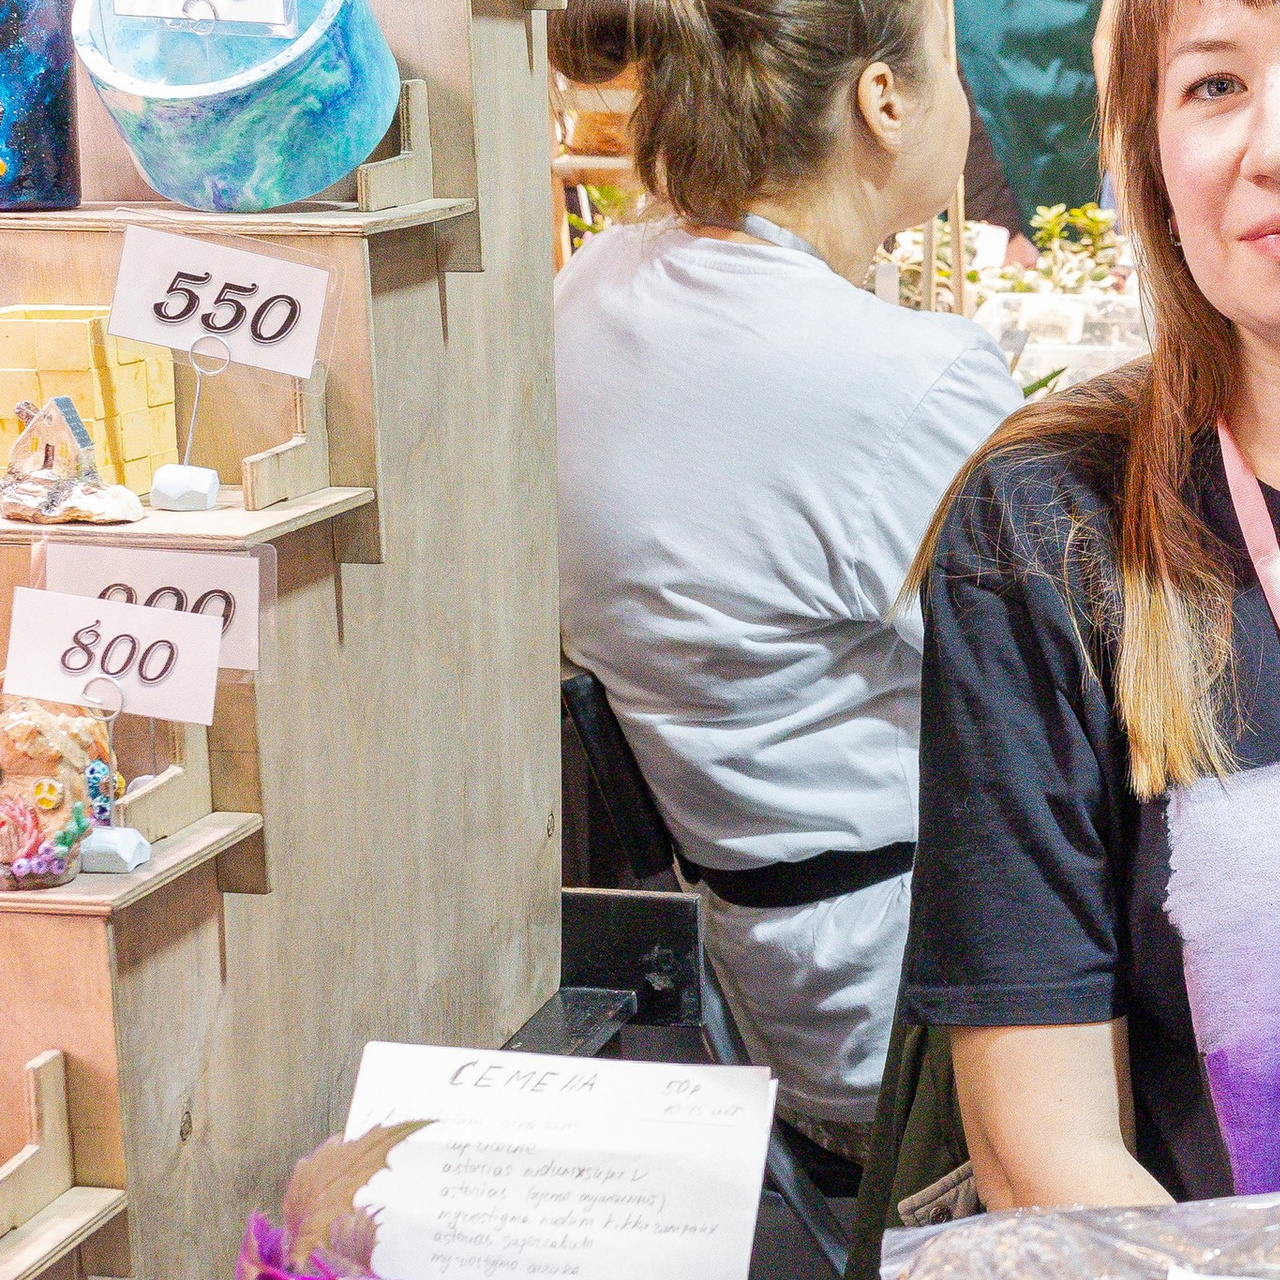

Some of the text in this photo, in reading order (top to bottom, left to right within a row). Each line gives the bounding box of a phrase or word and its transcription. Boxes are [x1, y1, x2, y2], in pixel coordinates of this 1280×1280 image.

[153, 271, 302, 347] 550
[61, 619, 179, 686] 800
[448, 1058, 600, 1095] СЕМЕНА
